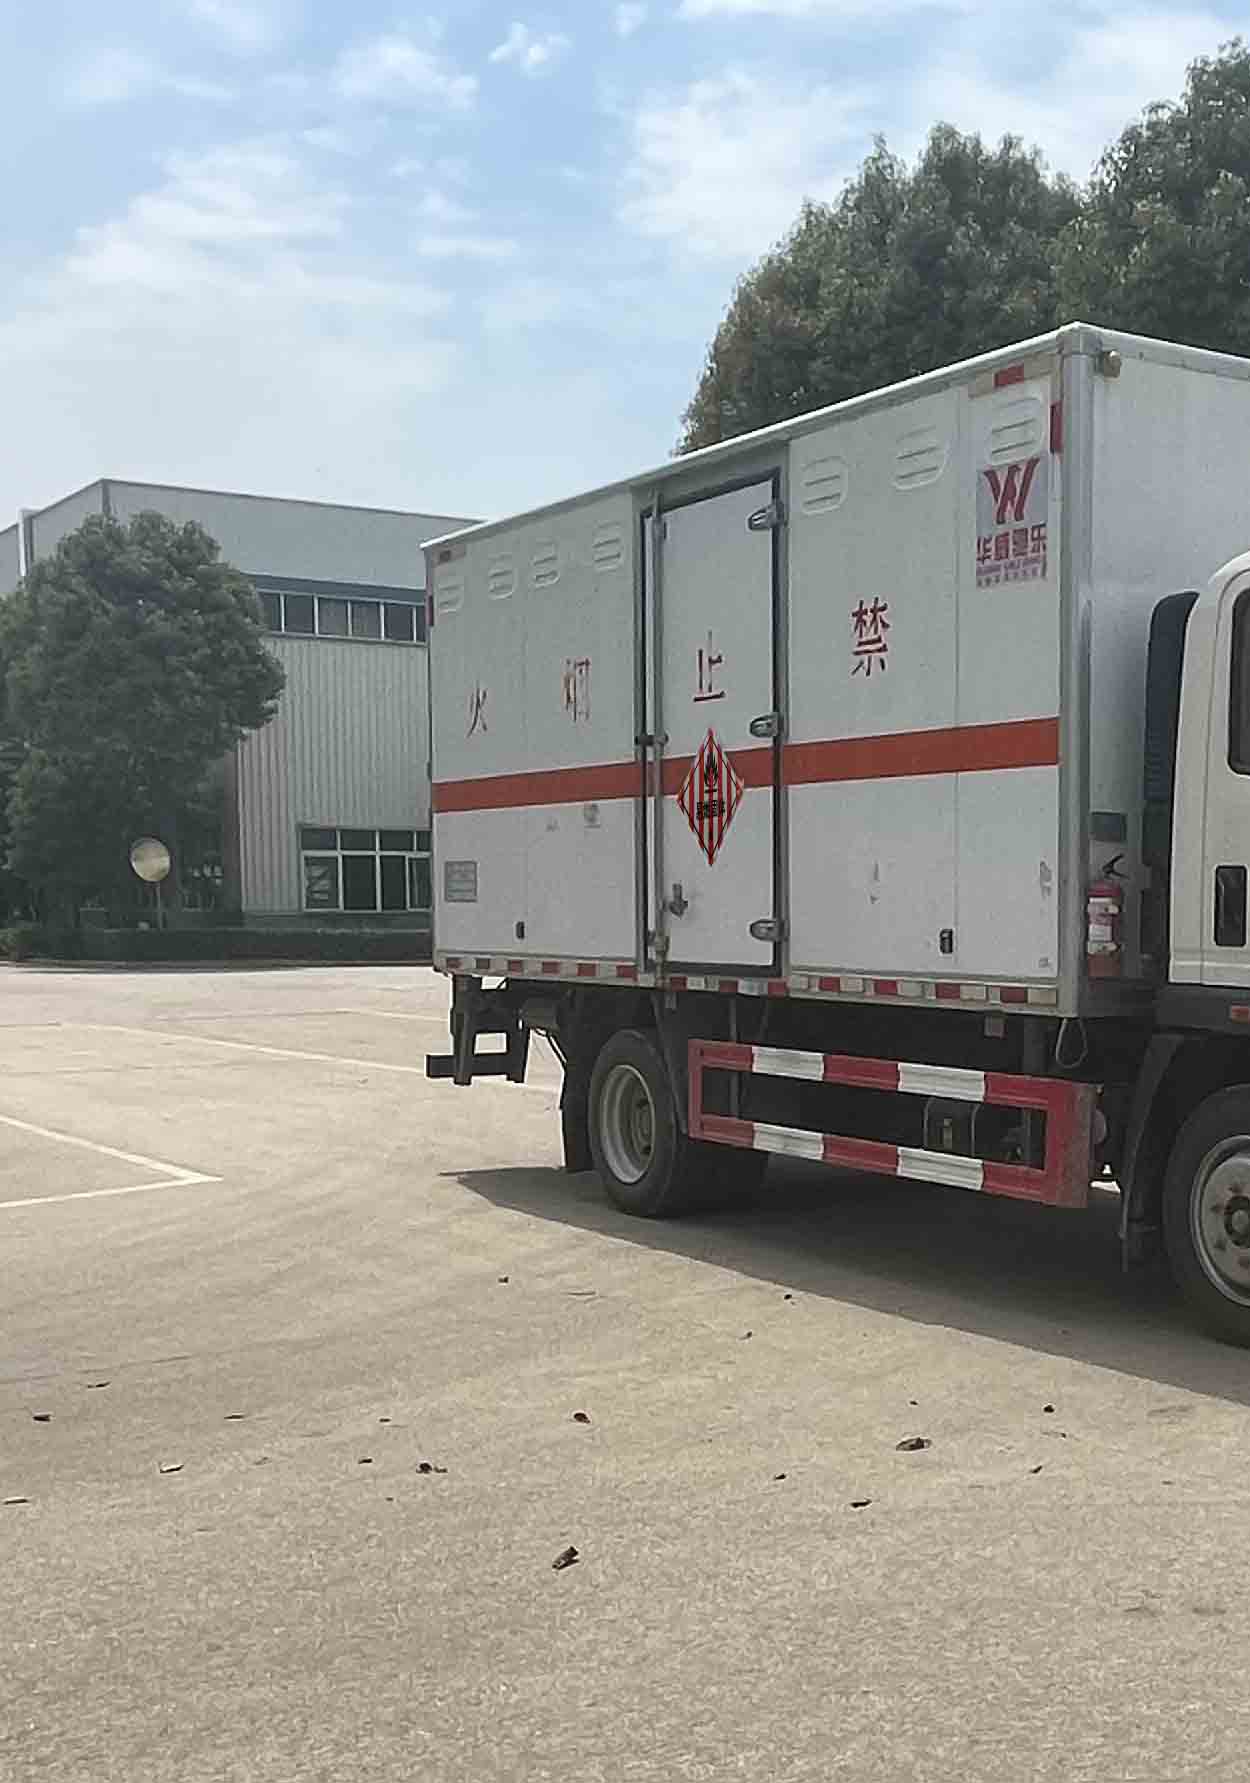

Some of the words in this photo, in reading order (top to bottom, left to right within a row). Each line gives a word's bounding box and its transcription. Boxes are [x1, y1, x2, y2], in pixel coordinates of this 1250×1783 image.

[693, 629, 727, 702] 止
[851, 597, 890, 677] 禁
[466, 680, 488, 738] 火
